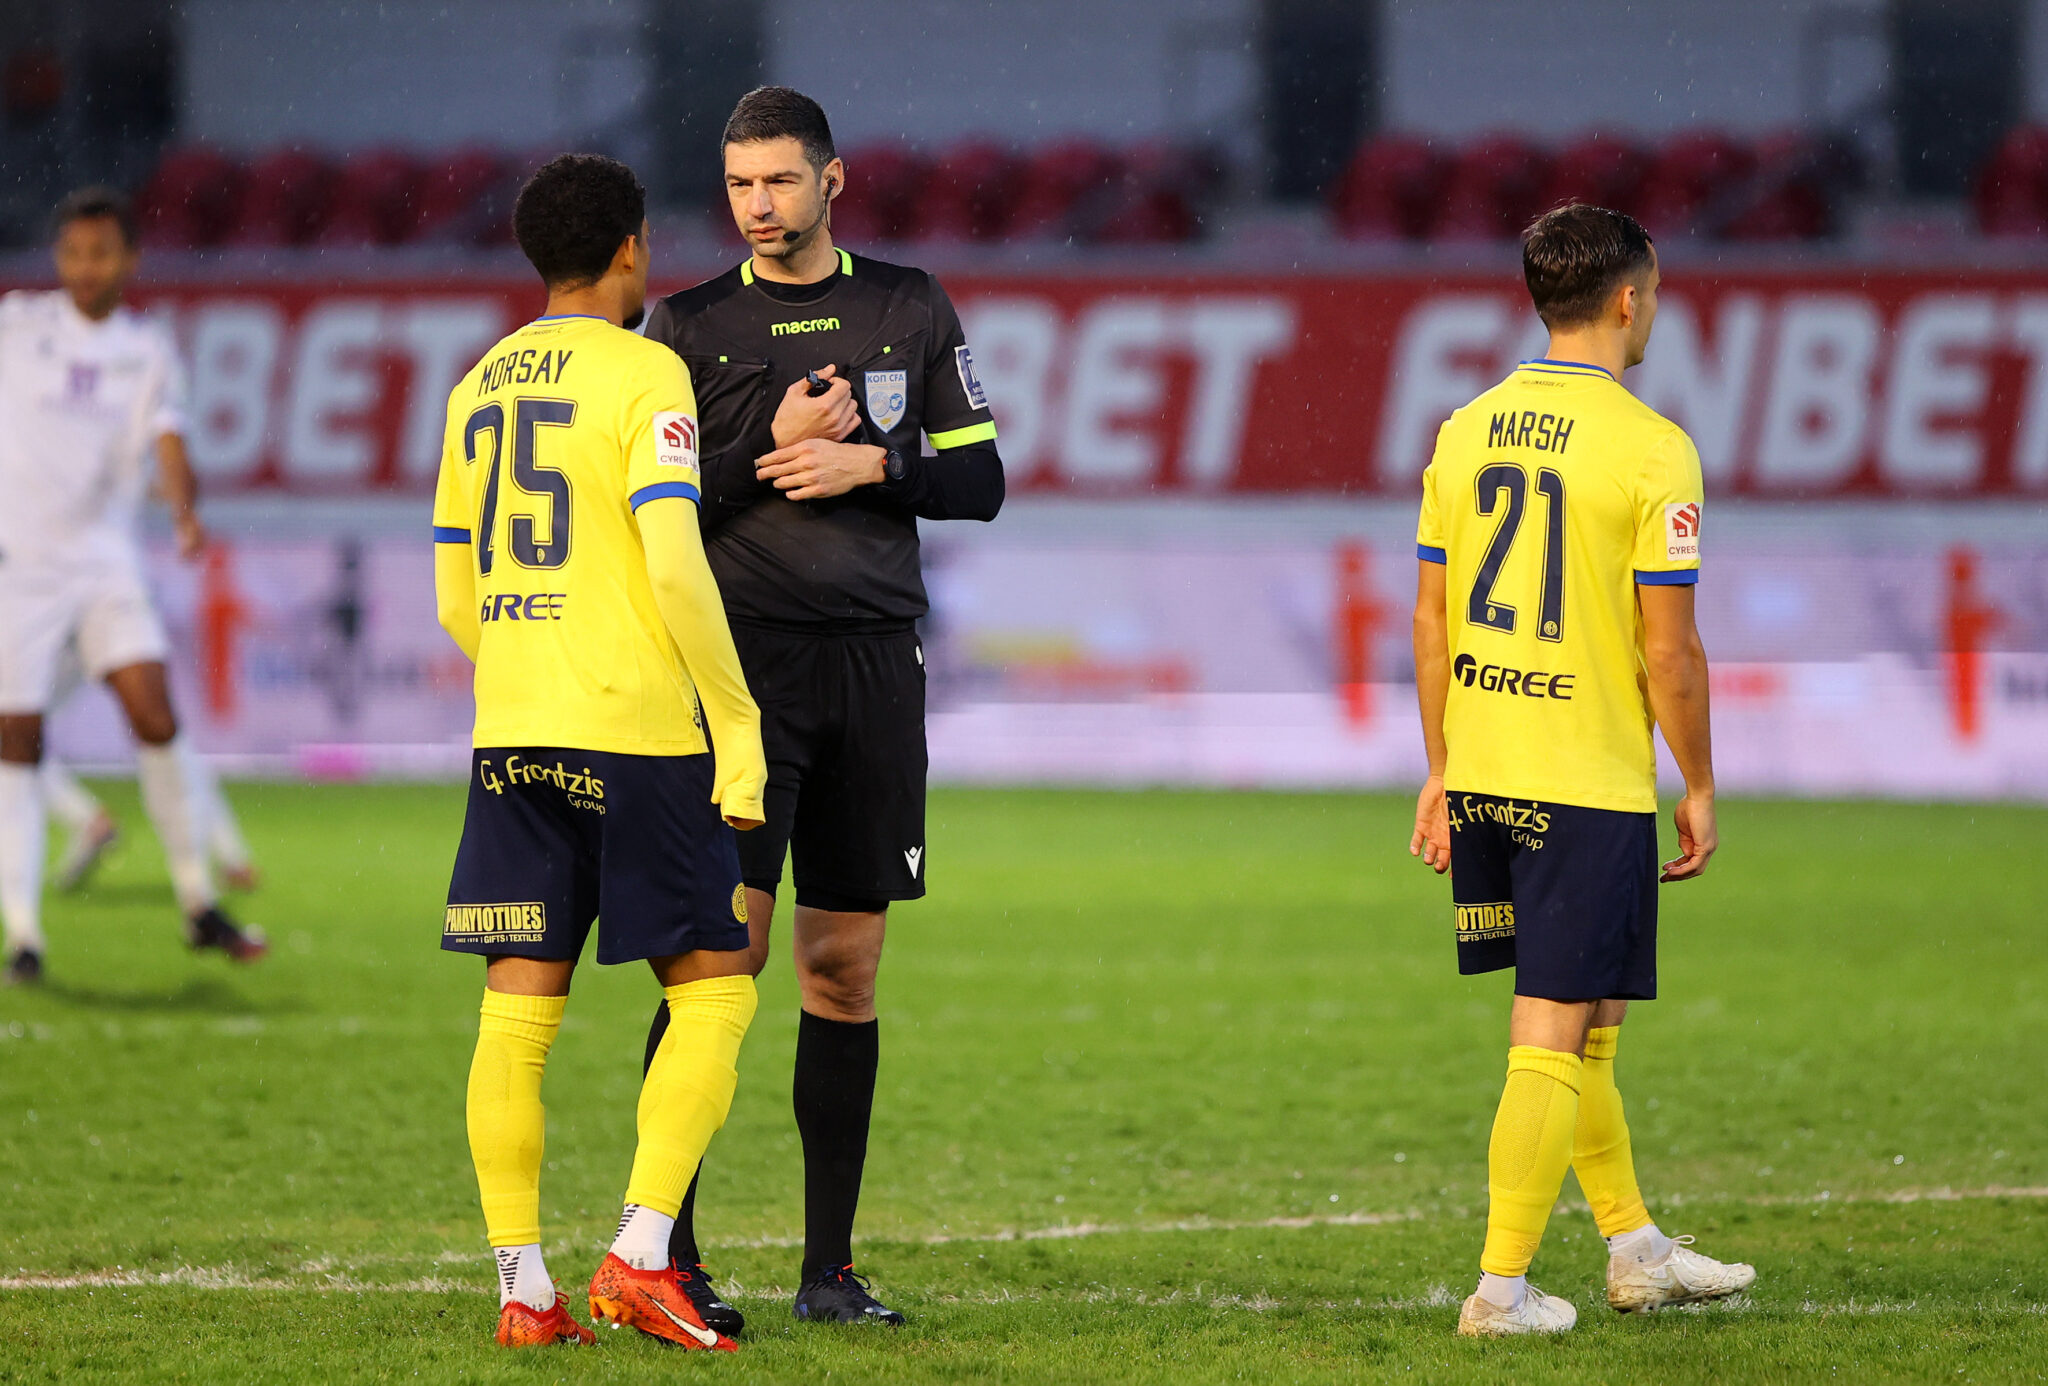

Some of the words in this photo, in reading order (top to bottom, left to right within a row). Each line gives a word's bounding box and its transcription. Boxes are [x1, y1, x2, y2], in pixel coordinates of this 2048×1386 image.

[771, 317, 840, 336] macron
[477, 350, 573, 397] MORSAY
[1488, 411, 1574, 454] MARSH
[660, 455, 688, 465] CYRES
[1466, 462, 1566, 643] 21
[1668, 545, 1697, 555] CYRES
[1479, 664, 1576, 700] GREE
[567, 793, 606, 815] Group
[1511, 829, 1544, 851] Grup
[483, 934, 506, 944] GIFTS
[509, 933, 543, 943] TEXTILES
